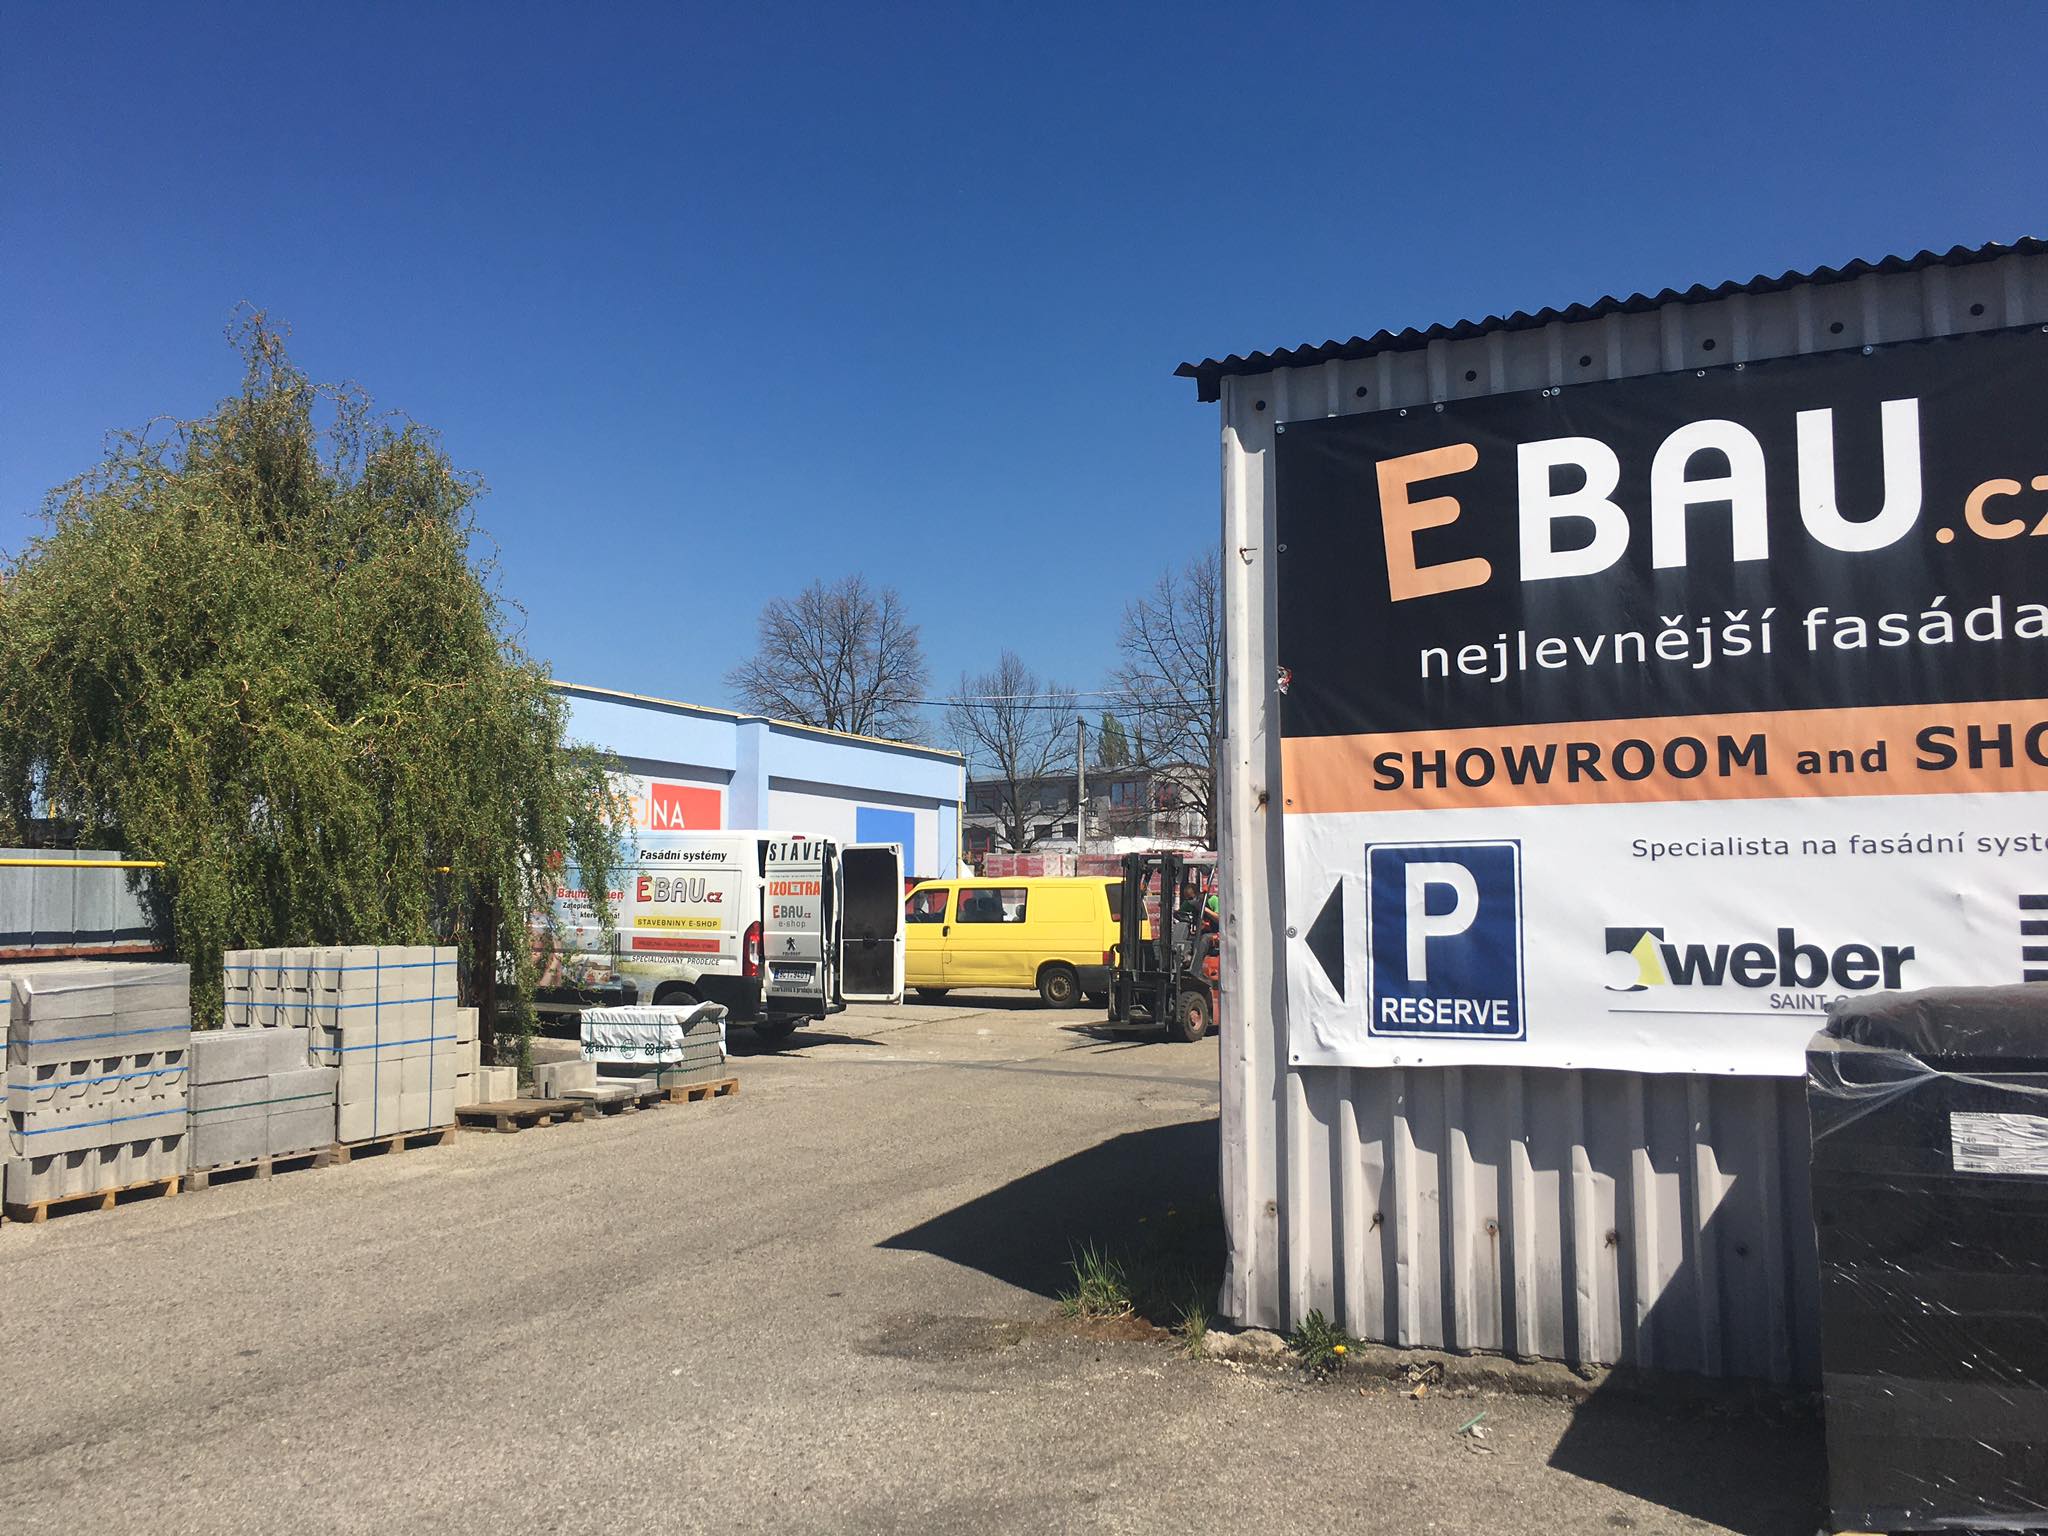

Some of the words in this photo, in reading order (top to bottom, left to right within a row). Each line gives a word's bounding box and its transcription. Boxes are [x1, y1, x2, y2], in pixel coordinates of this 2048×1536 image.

[1420, 606, 1773, 684] nejlevnější
[1803, 594, 2048, 651] fasáda
[1372, 733, 1769, 791] SHOWROOM
[1797, 741, 1888, 774] and
[640, 849, 681, 860] Fasádní
[683, 849, 727, 862] systémy
[769, 842, 822, 861] STAVE
[1632, 836, 1789, 861] Specialista
[1801, 838, 1837, 855] na
[1849, 831, 1965, 855] fasádní
[1977, 831, 2048, 857] syst
[636, 875, 723, 903] EBAU.cz
[637, 918, 686, 927] STAVEBNINY
[688, 920, 718, 928] E-SHOP
[1405, 862, 1479, 981] P
[1659, 927, 1916, 989] weber
[1381, 997, 1511, 1026] RESERVE
